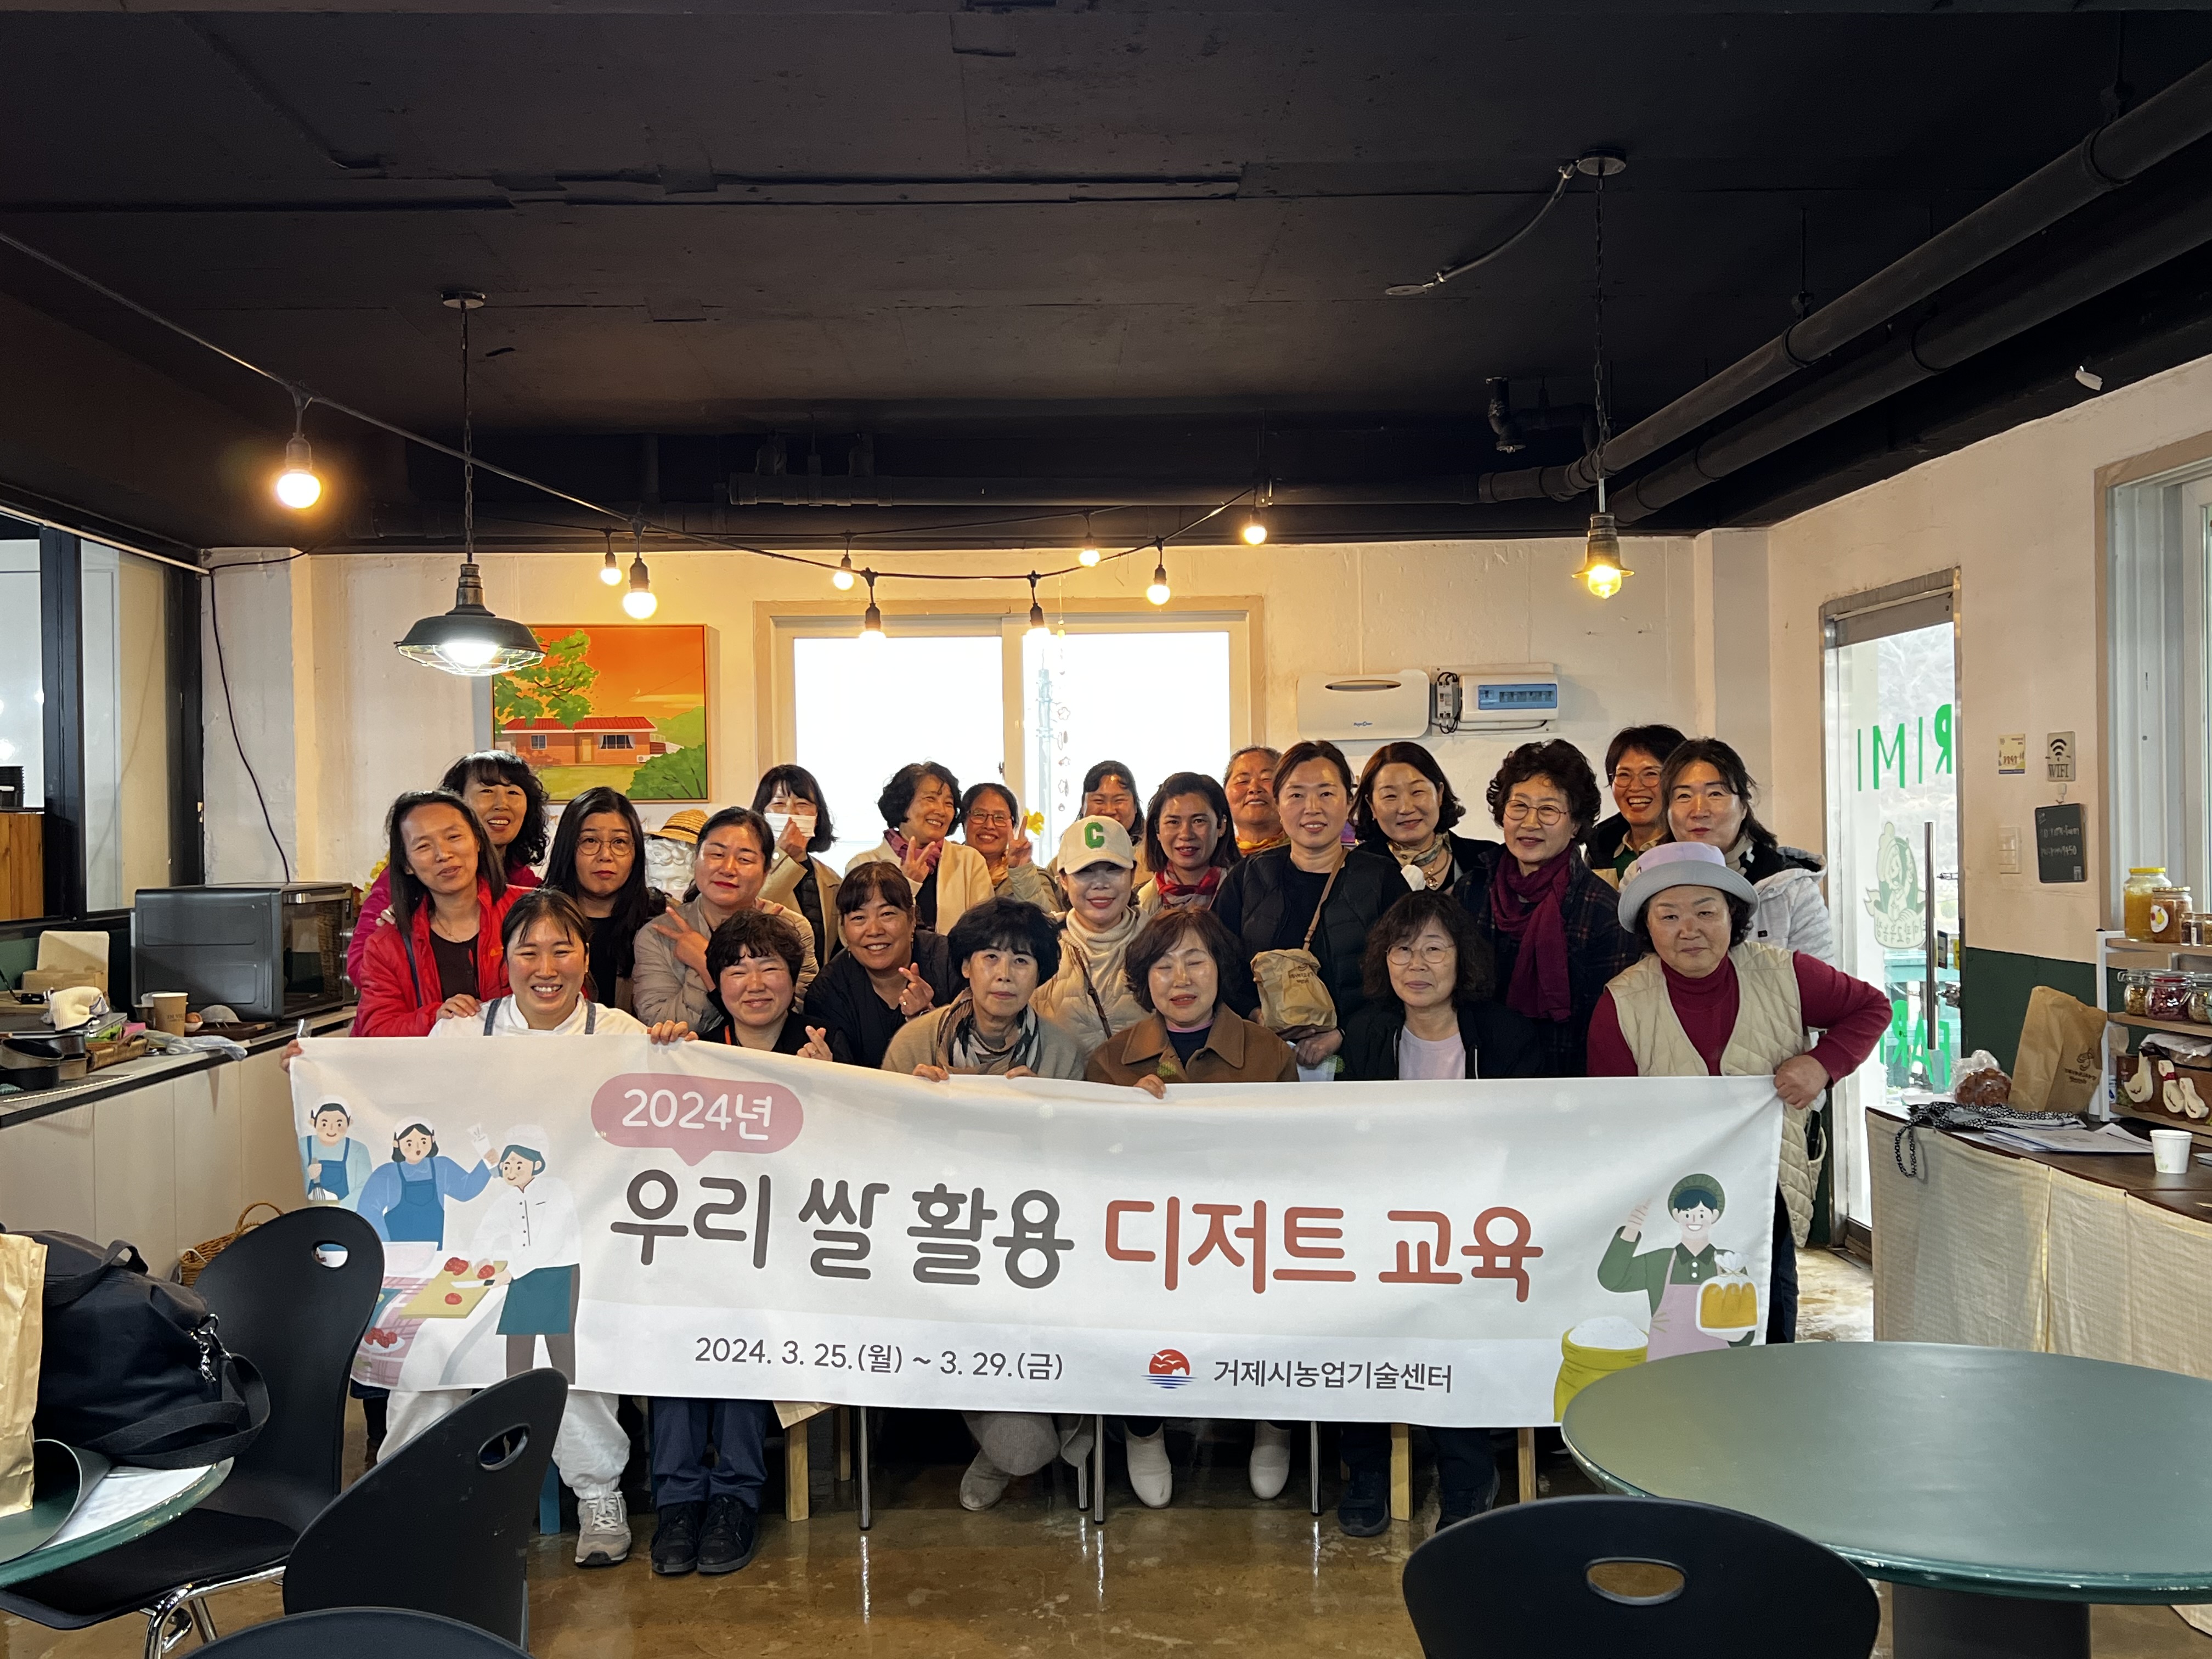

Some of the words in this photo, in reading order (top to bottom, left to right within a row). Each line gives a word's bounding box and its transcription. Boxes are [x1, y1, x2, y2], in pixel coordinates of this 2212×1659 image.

[2047, 763, 2069, 778] WIFI
[1084, 822, 1105, 849] C
[622, 1088, 772, 1141] 2024년
[610, 1169, 771, 1269] 우리
[798, 1178, 890, 1280] 쌀
[906, 1182, 1075, 1289] 활용
[1105, 1196, 1357, 1294] 디저트
[1378, 1206, 1544, 1303] 교육
[695, 1337, 771, 1364] 2024.
[782, 1340, 804, 1365] 3.
[939, 1351, 962, 1375] 3.
[1213, 1359, 1452, 1394] 거제시농업기술센터
